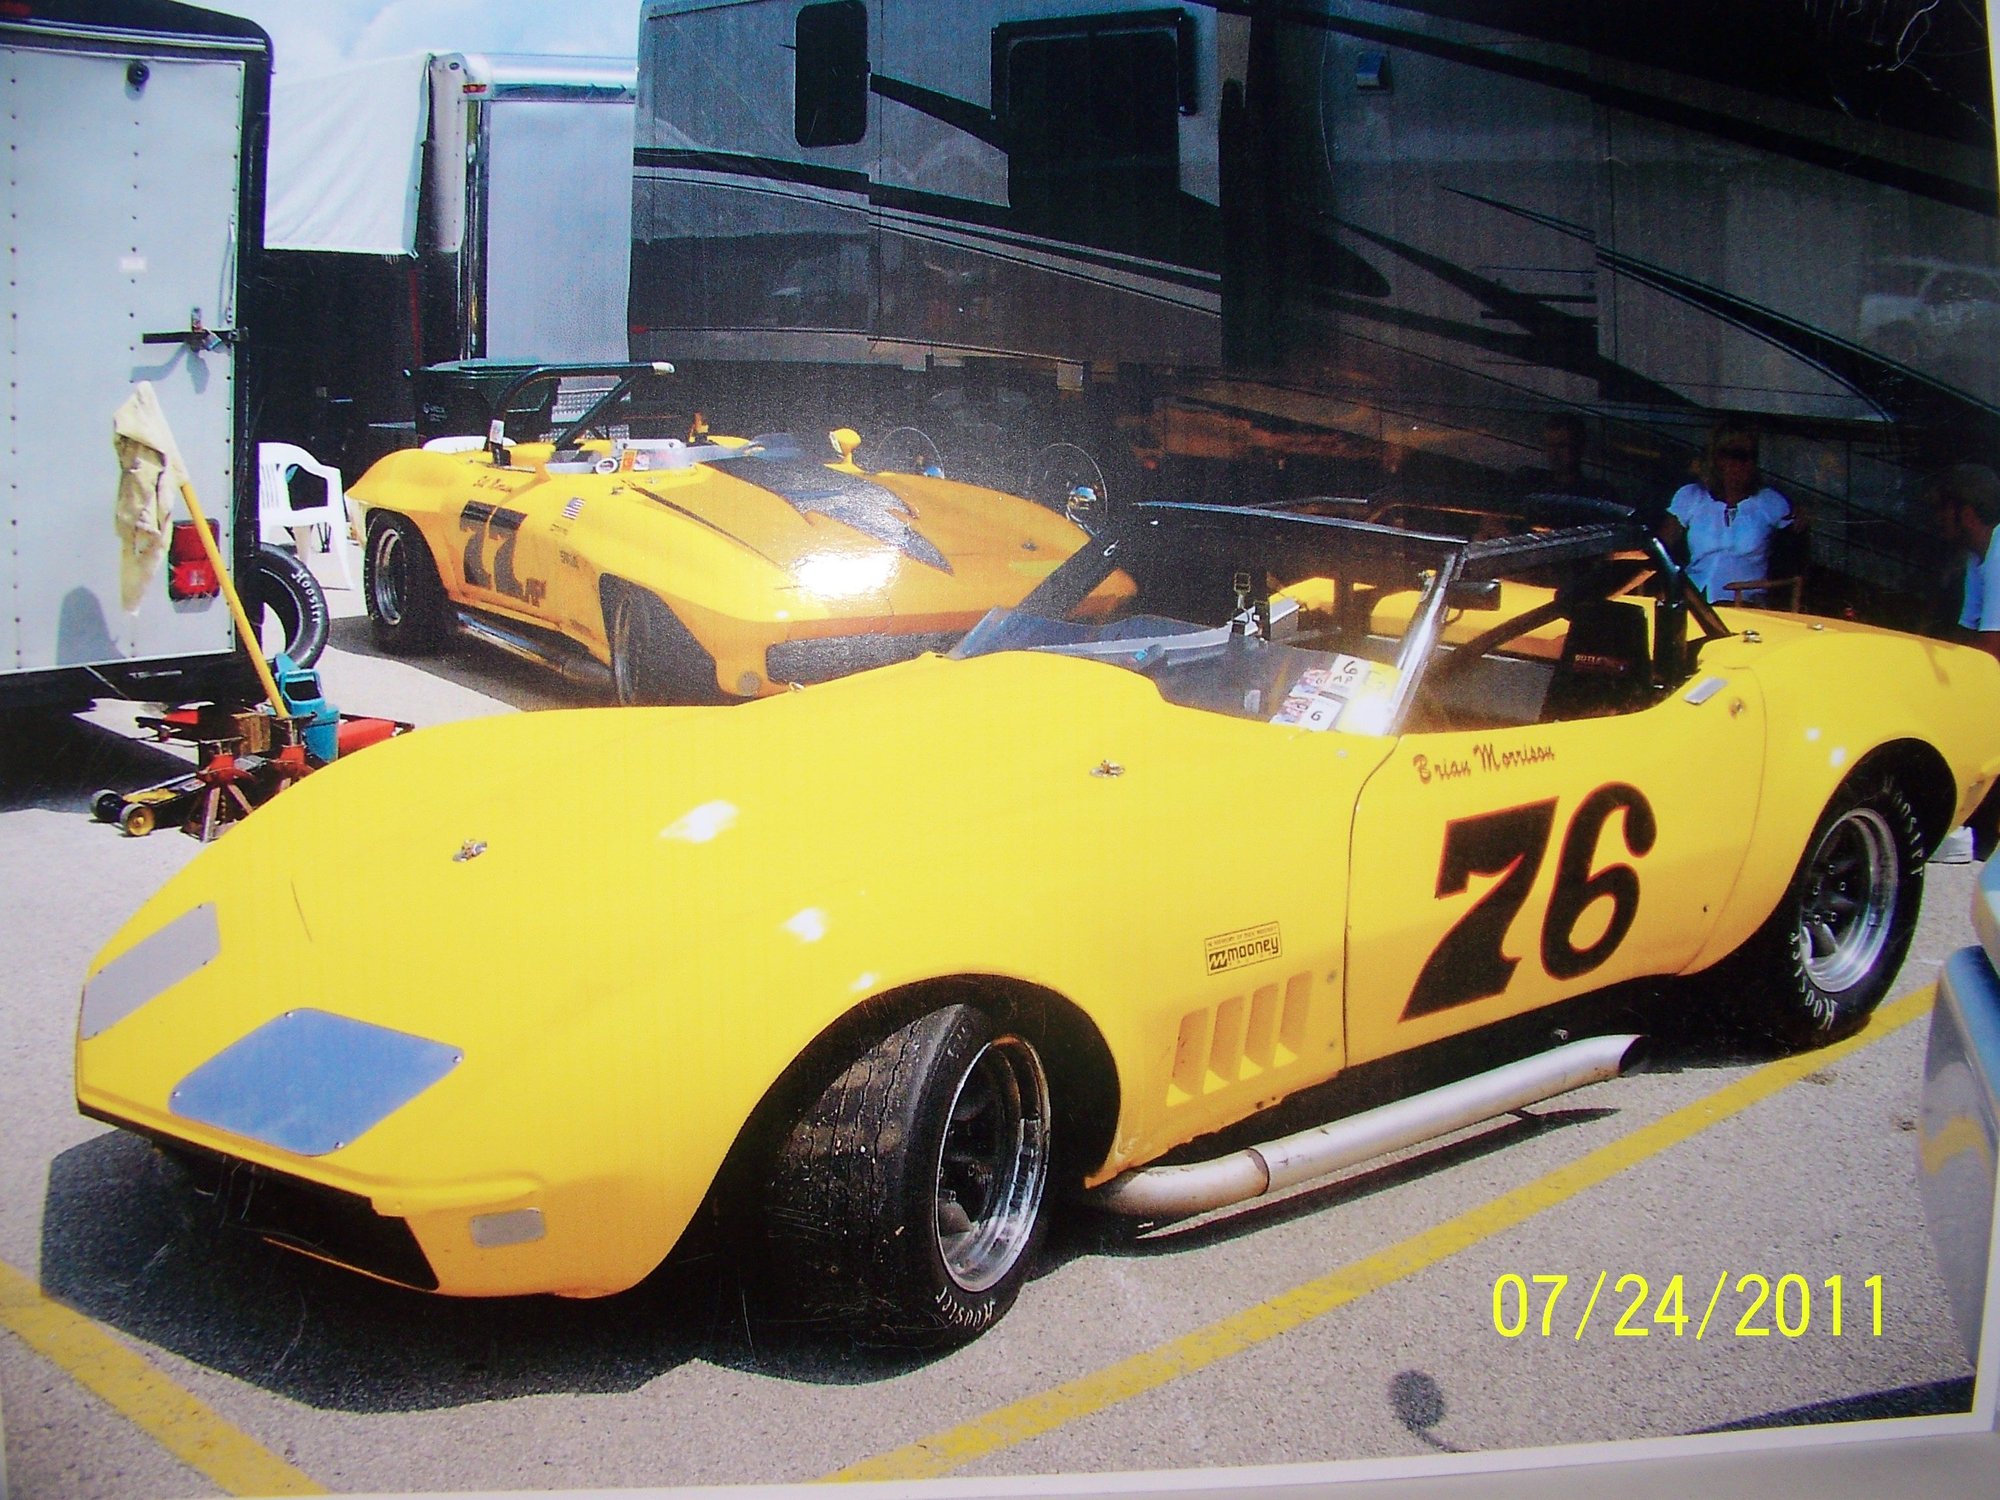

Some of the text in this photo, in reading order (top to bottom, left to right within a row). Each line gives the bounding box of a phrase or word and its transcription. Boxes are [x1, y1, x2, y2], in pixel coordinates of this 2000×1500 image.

[459, 500, 531, 602] 77
[1343, 660, 1358, 675] 6
[1413, 744, 1555, 784] Brian Morrison
[1397, 781, 1657, 1024] 76
[1227, 936, 1279, 961] mooney
